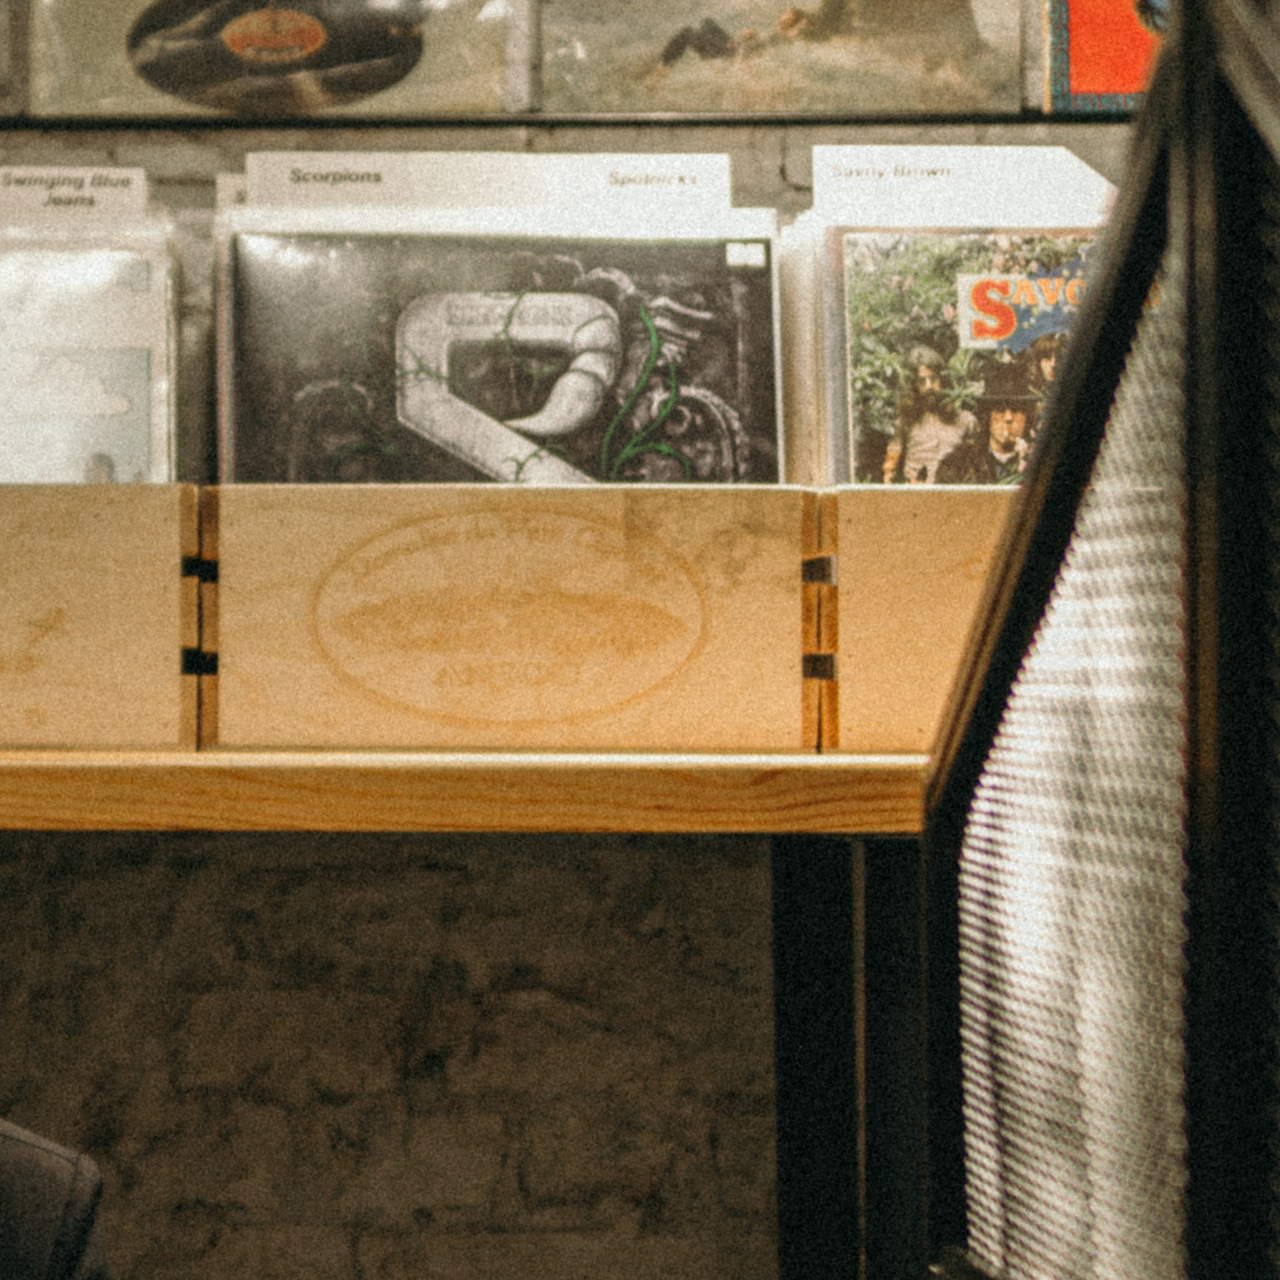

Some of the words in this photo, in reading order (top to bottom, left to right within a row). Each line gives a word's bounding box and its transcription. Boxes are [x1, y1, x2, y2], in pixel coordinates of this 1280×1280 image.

[290, 167, 383, 186] Scorpions
[893, 164, 952, 178] Brown
[2, 170, 85, 191] Swinging
[91, 171, 132, 188] Blue
[43, 192, 96, 208] Jeans
